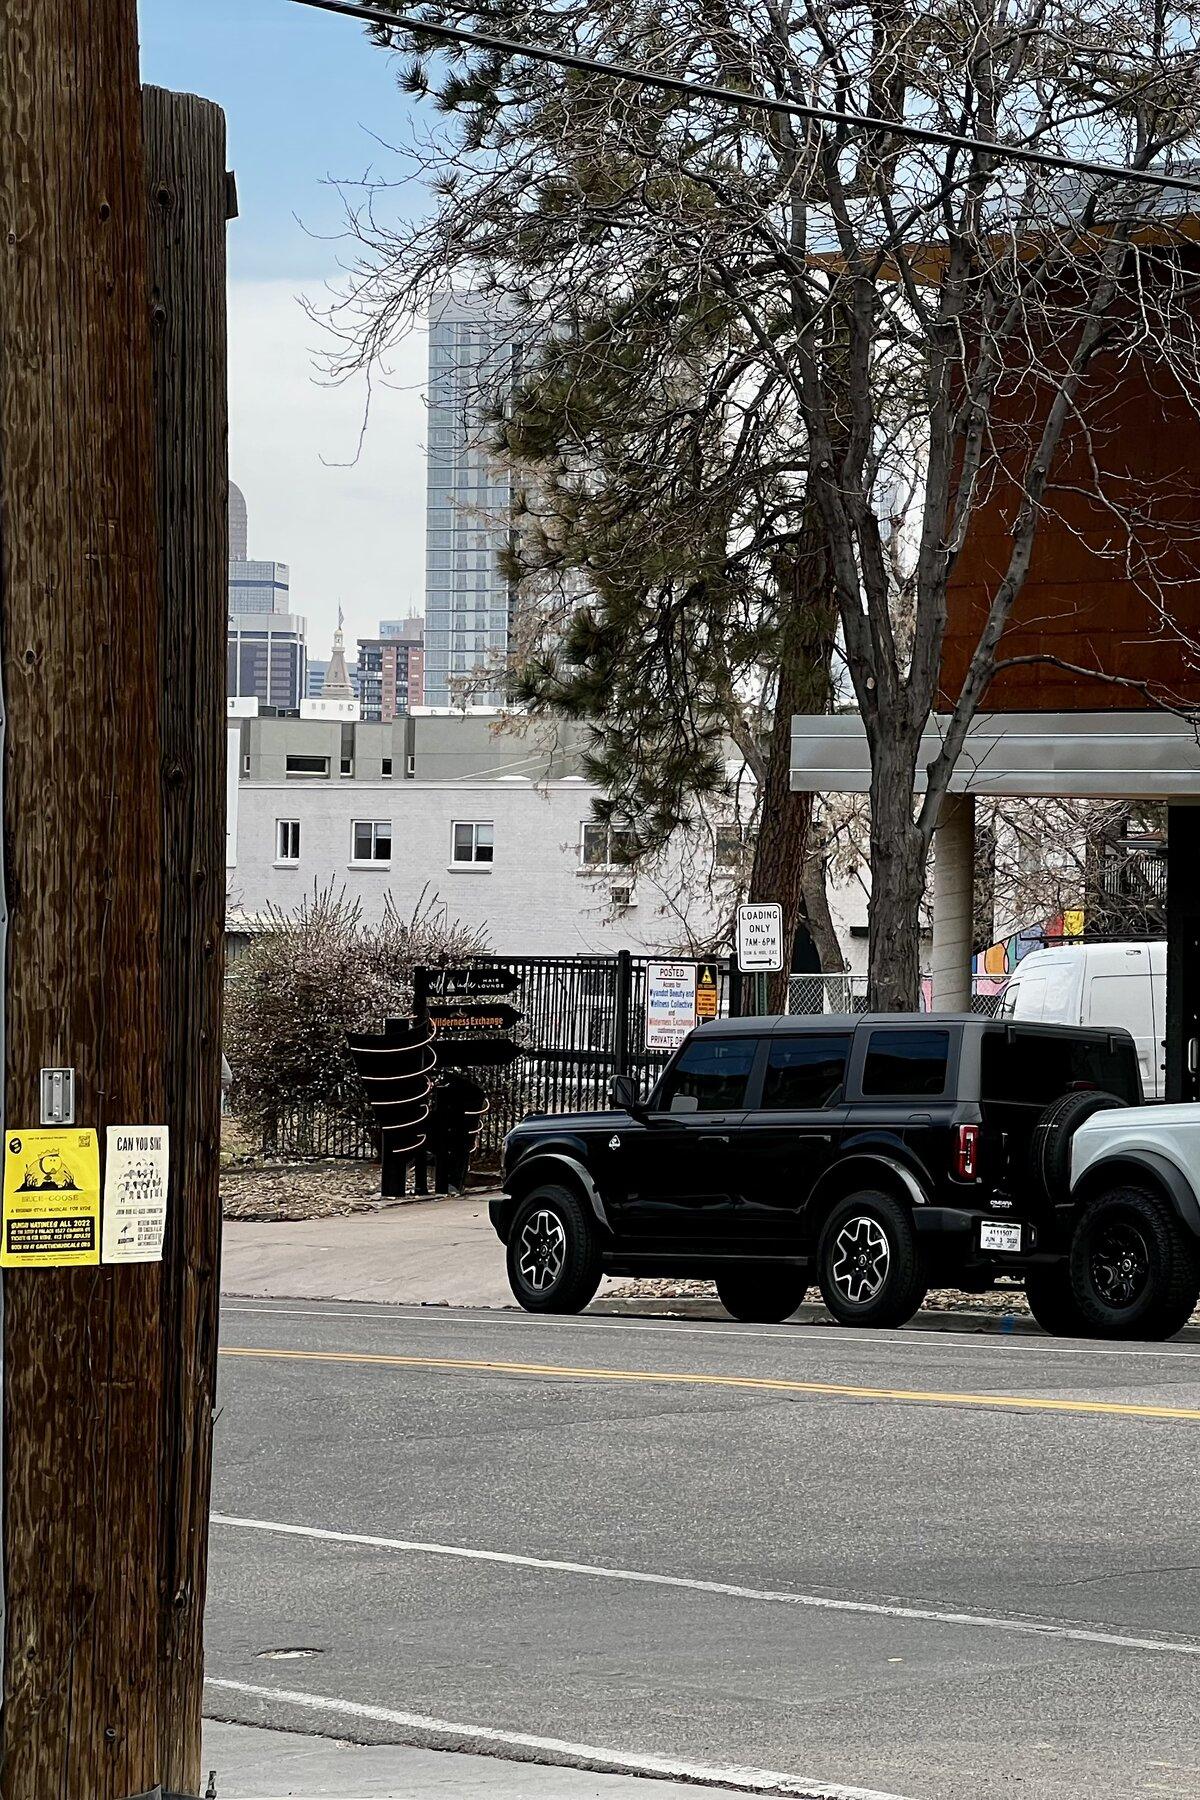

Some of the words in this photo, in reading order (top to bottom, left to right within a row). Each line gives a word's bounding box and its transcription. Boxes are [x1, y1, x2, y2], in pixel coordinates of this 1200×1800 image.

[742, 911, 778, 920] LOADING
[749, 924, 770, 933] ONLY
[745, 938, 776, 946] 7AM-6PM
[660, 968, 684, 977] POSTED
[670, 989, 685, 998] Beauty
[671, 1000, 692, 1008] Collective
[470, 1017, 503, 1025] Exchange
[673, 1018, 693, 1026] Exchange
[651, 1036, 673, 1044] PRIVATE
[117, 1137, 133, 1151] CAN
[136, 1137, 148, 1150] YOU
